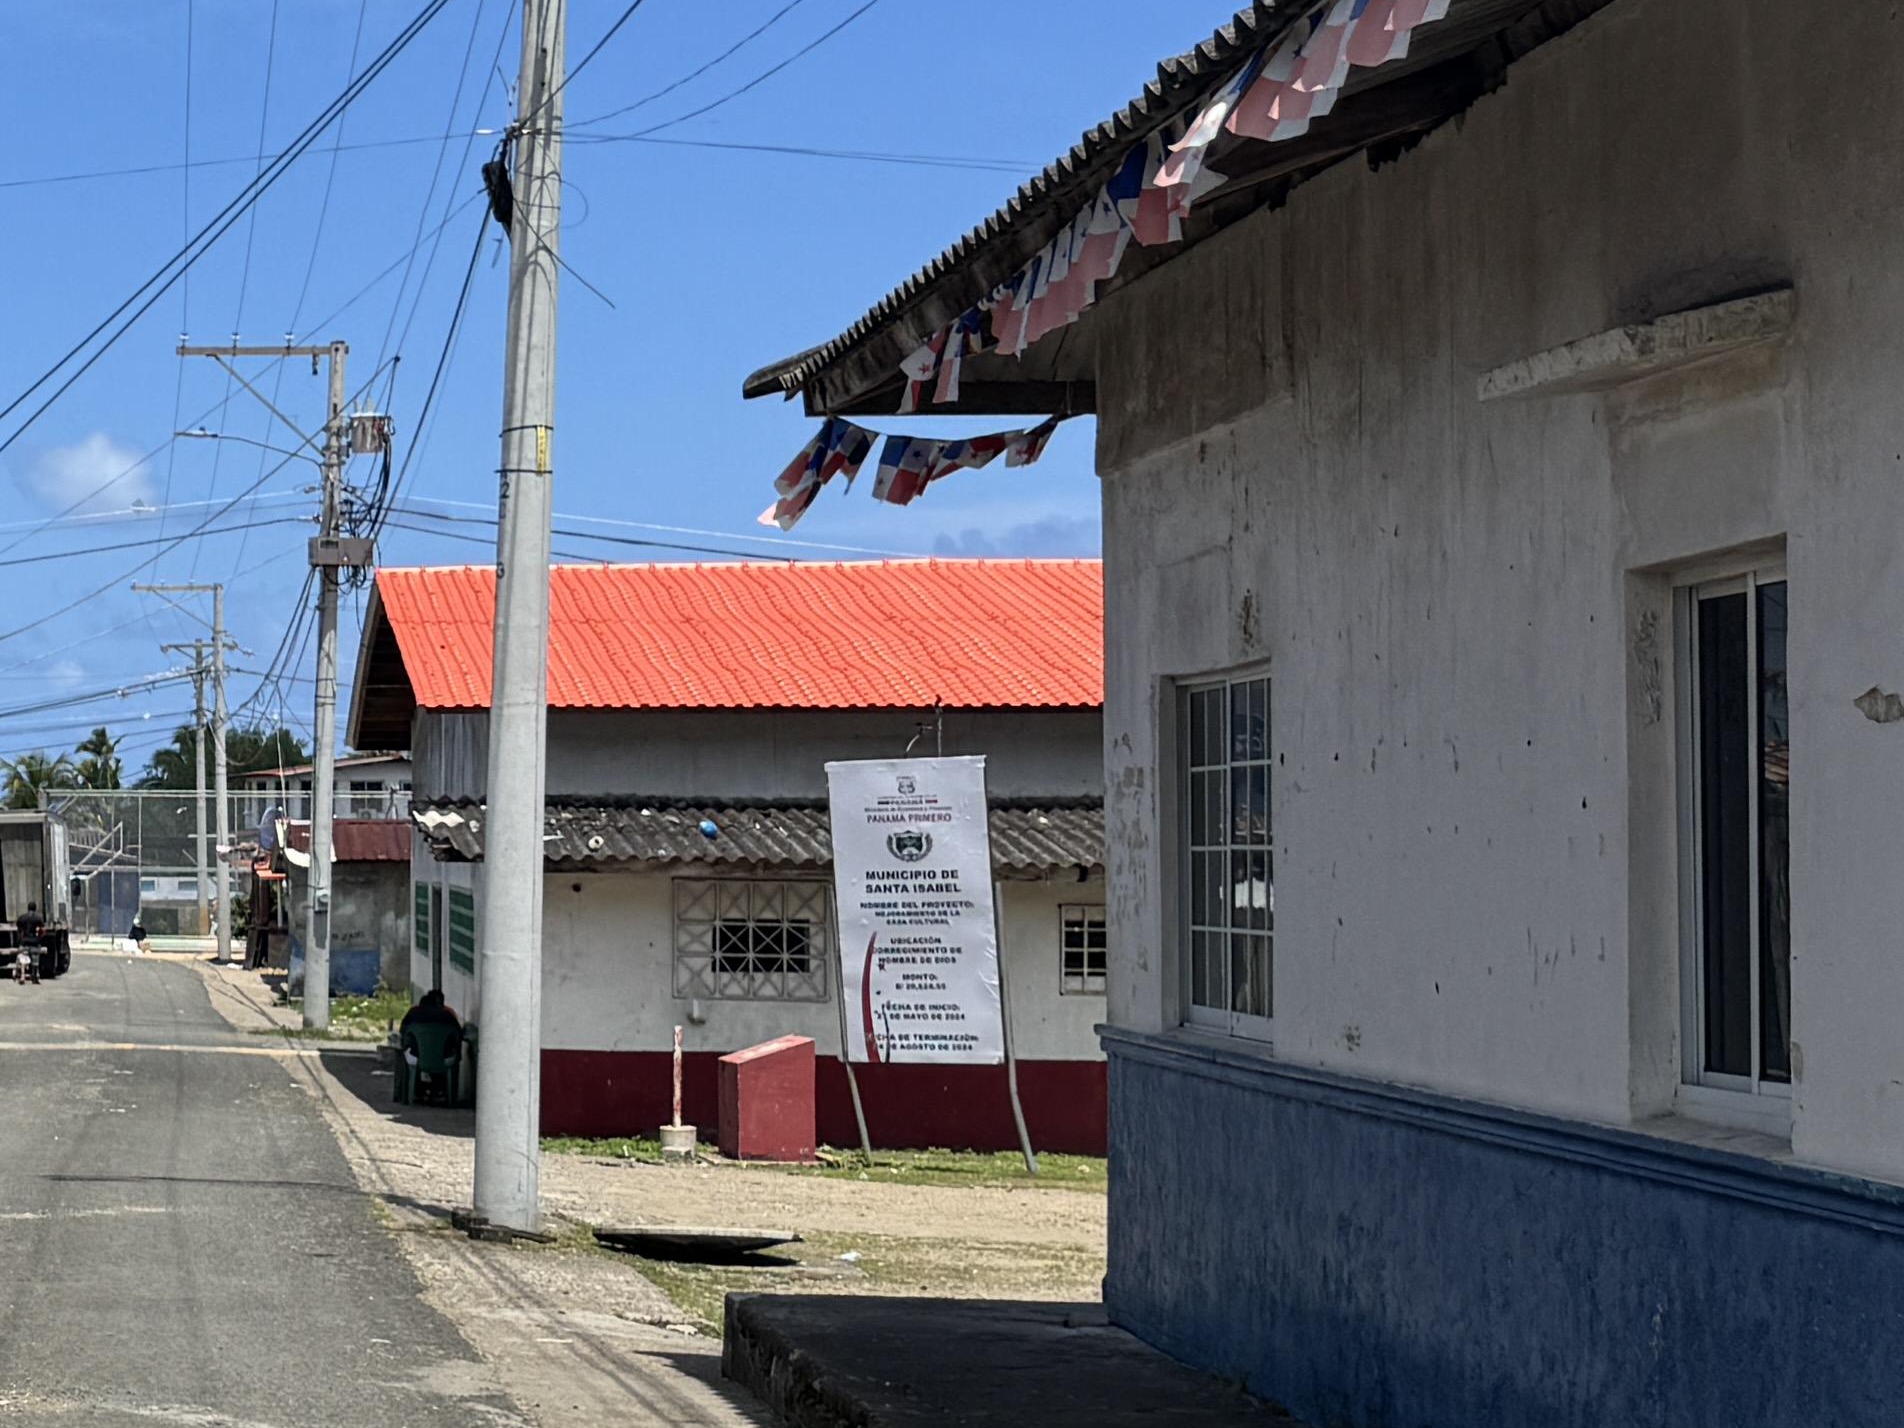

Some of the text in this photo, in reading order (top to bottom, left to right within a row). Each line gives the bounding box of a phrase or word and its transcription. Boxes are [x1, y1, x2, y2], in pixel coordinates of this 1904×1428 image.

[865, 869, 959, 880] MUNICIPIO DE
[865, 883, 961, 893] SANTA ISABEL
[860, 901, 898, 909] NOMBRE
[901, 901, 918, 909] DEL
